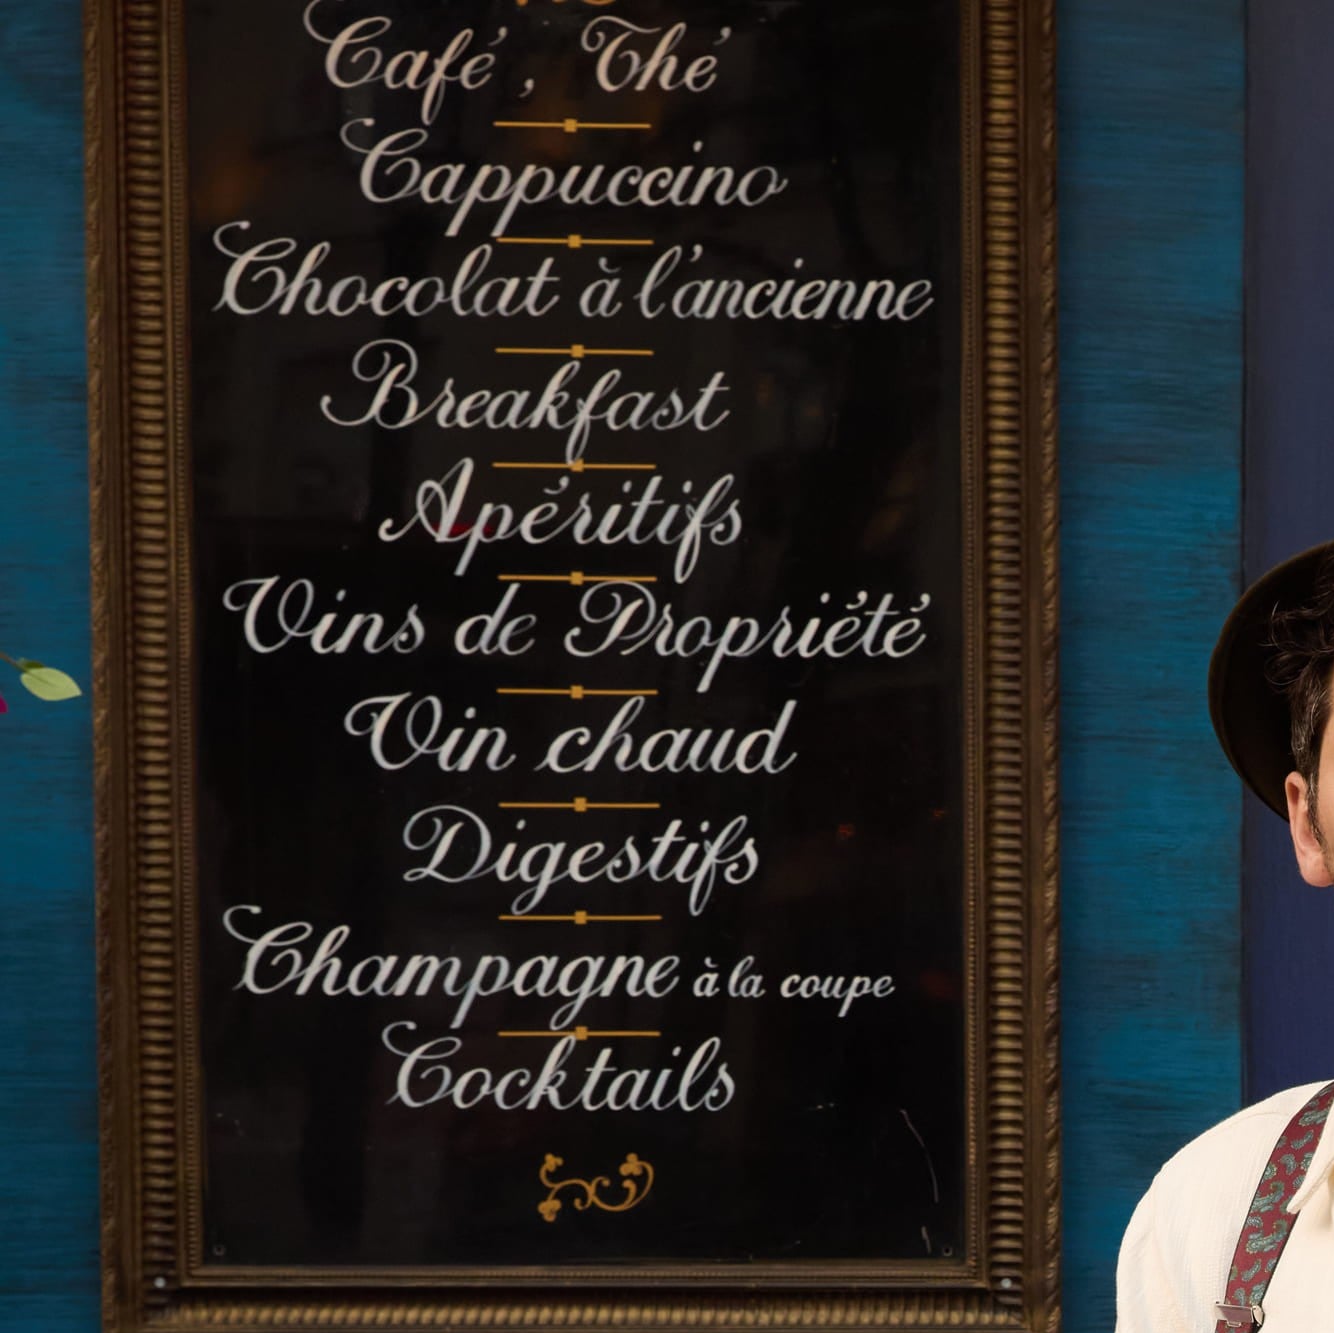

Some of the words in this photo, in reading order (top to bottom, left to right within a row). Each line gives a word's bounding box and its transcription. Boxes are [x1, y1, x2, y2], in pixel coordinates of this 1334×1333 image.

[581, 16, 732, 92] Thé
[341, 118, 788, 237] Cappuccino
[212, 221, 560, 317] Chocolat
[579, 257, 622, 318] à
[635, 244, 934, 321] l'ancienne
[320, 338, 731, 467] Breakfast
[378, 457, 743, 584] Apéritifs
[222, 576, 425, 654] Vins
[454, 582, 537, 656] de
[564, 580, 931, 694] Propriété
[344, 692, 517, 772] Vin
[534, 695, 798, 774] chaud
[403, 804, 760, 916] Digestifs
[222, 904, 680, 1031] Champagne
[692, 957, 721, 999] à
[727, 955, 766, 999] la
[780, 974, 896, 1018] coupe
[382, 1020, 736, 1112] Cocktails
